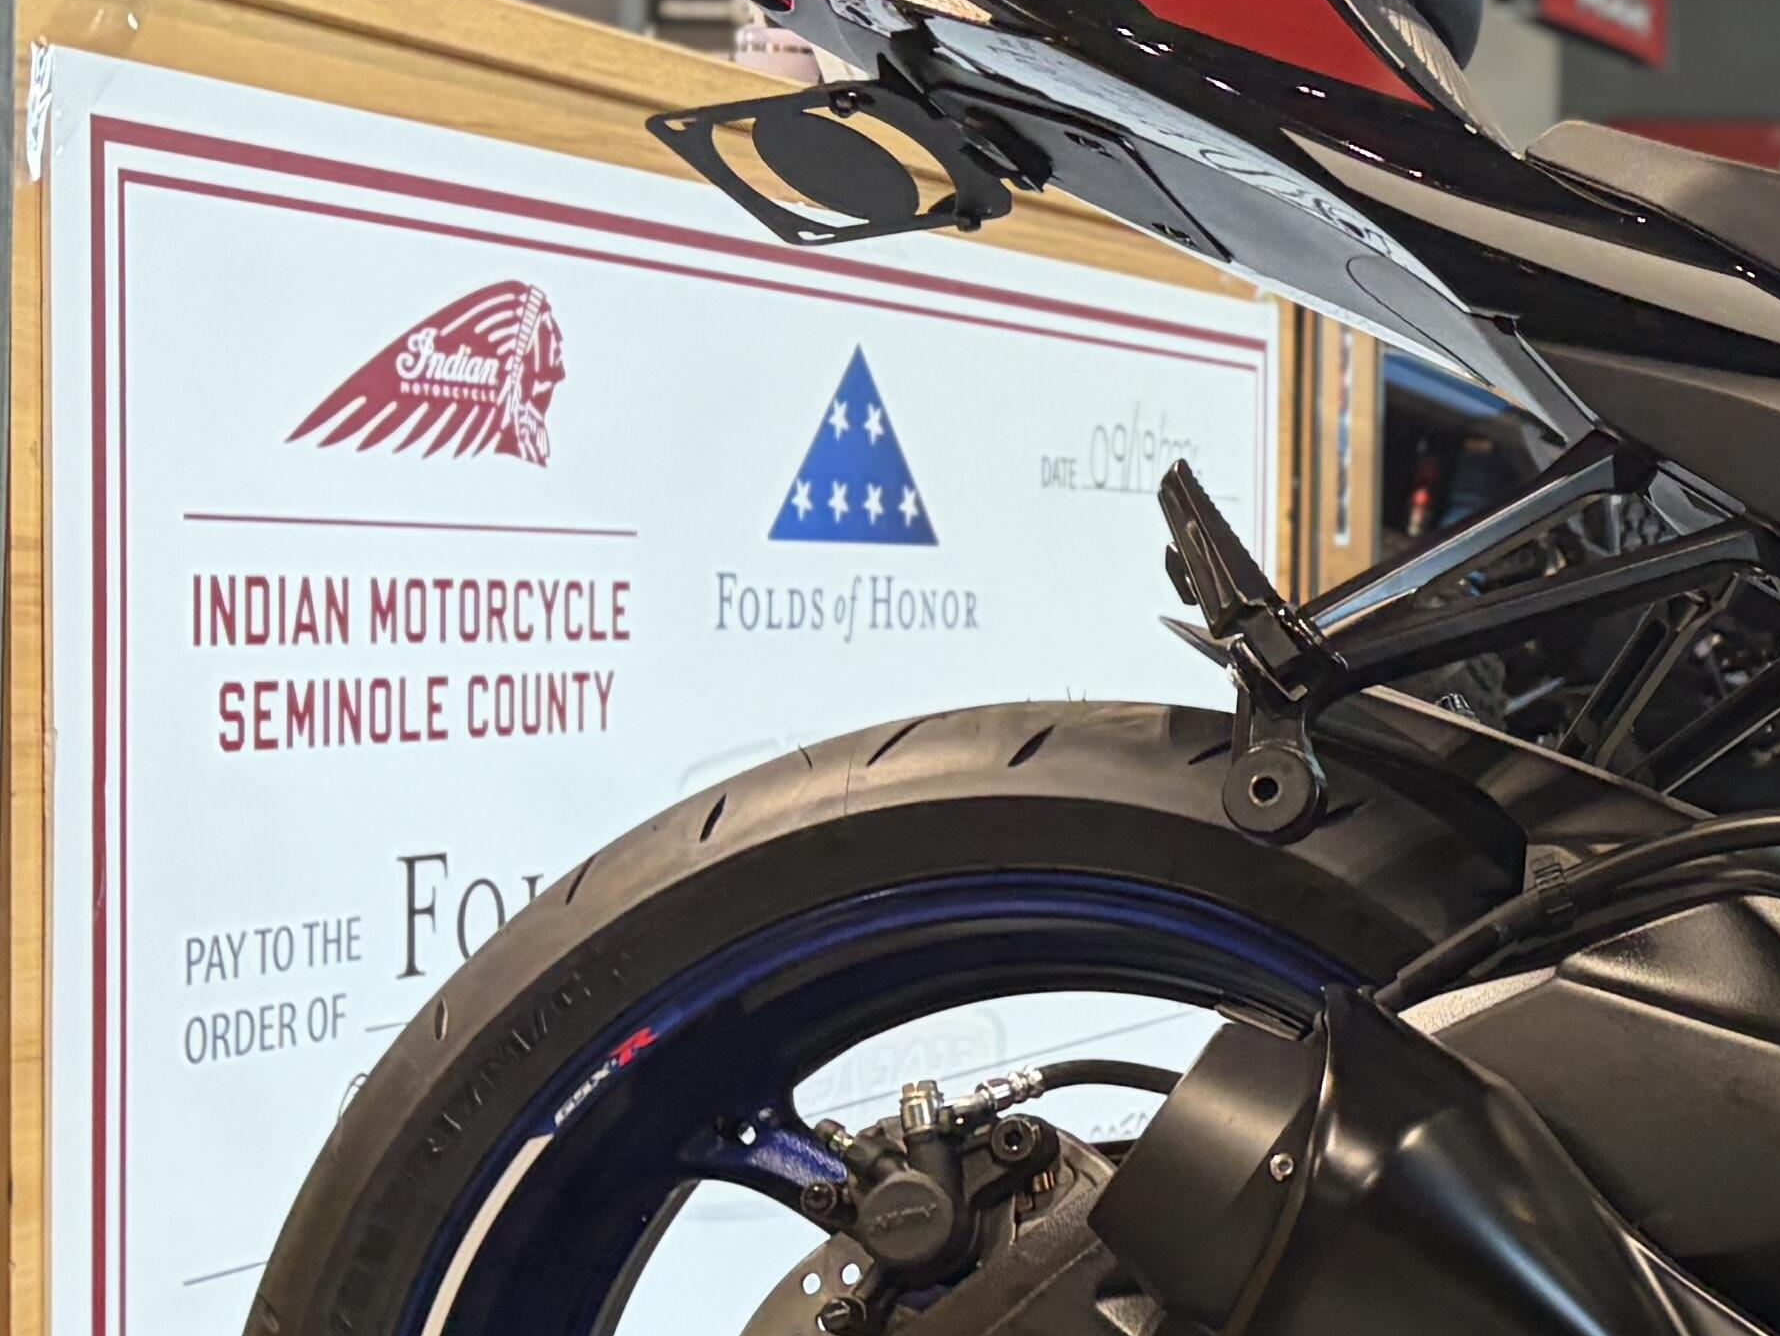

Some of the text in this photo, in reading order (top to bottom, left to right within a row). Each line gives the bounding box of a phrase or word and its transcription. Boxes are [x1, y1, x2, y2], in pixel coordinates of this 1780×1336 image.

[395, 327, 499, 385] Indian
[400, 380, 500, 403] MOTORCYCLE
[1041, 456, 1077, 489] DATE
[193, 574, 630, 646] INDIAN MOTORCYCLE
[715, 571, 978, 643] FOLDS of HONOR
[219, 670, 615, 752] SEMINOLE COUNTY
[185, 930, 247, 986] PAY
[253, 925, 295, 975] TO
[302, 917, 363, 969] THE
[185, 993, 347, 1065] ORDER OF
